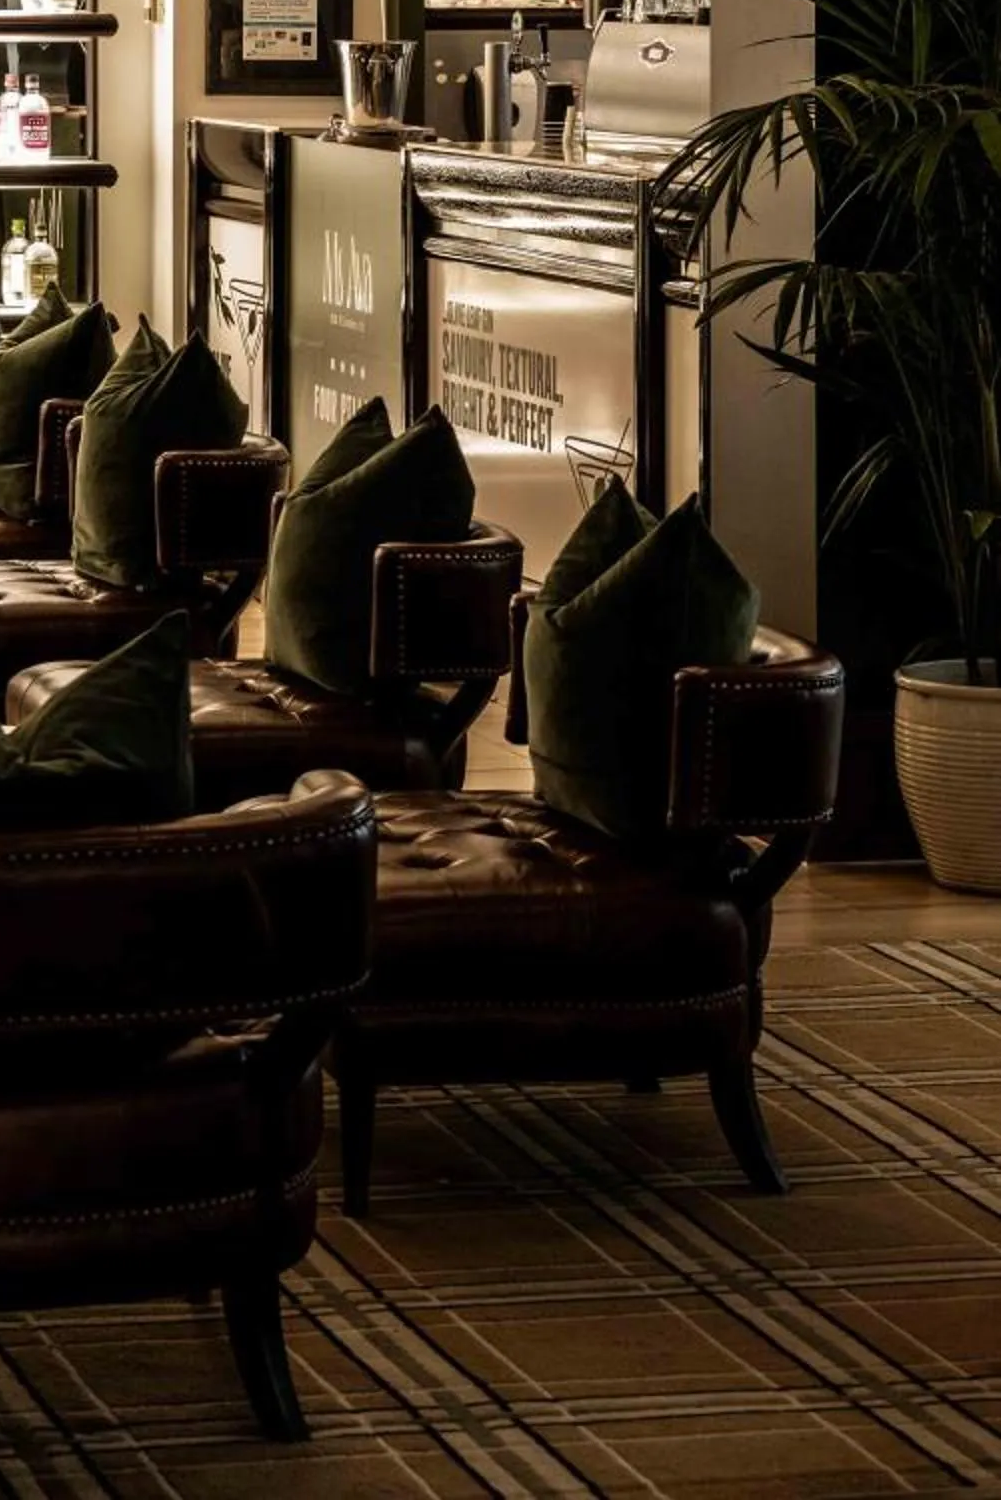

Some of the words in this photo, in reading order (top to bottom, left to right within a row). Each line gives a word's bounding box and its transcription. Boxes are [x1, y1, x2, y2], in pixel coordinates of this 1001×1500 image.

[442, 329, 496, 390] SAVOURY,
[498, 342, 564, 408] TEXTURAL,
[442, 379, 484, 433] BRIGHT
[486, 392, 499, 437] &
[500, 395, 555, 454] PERFECT
